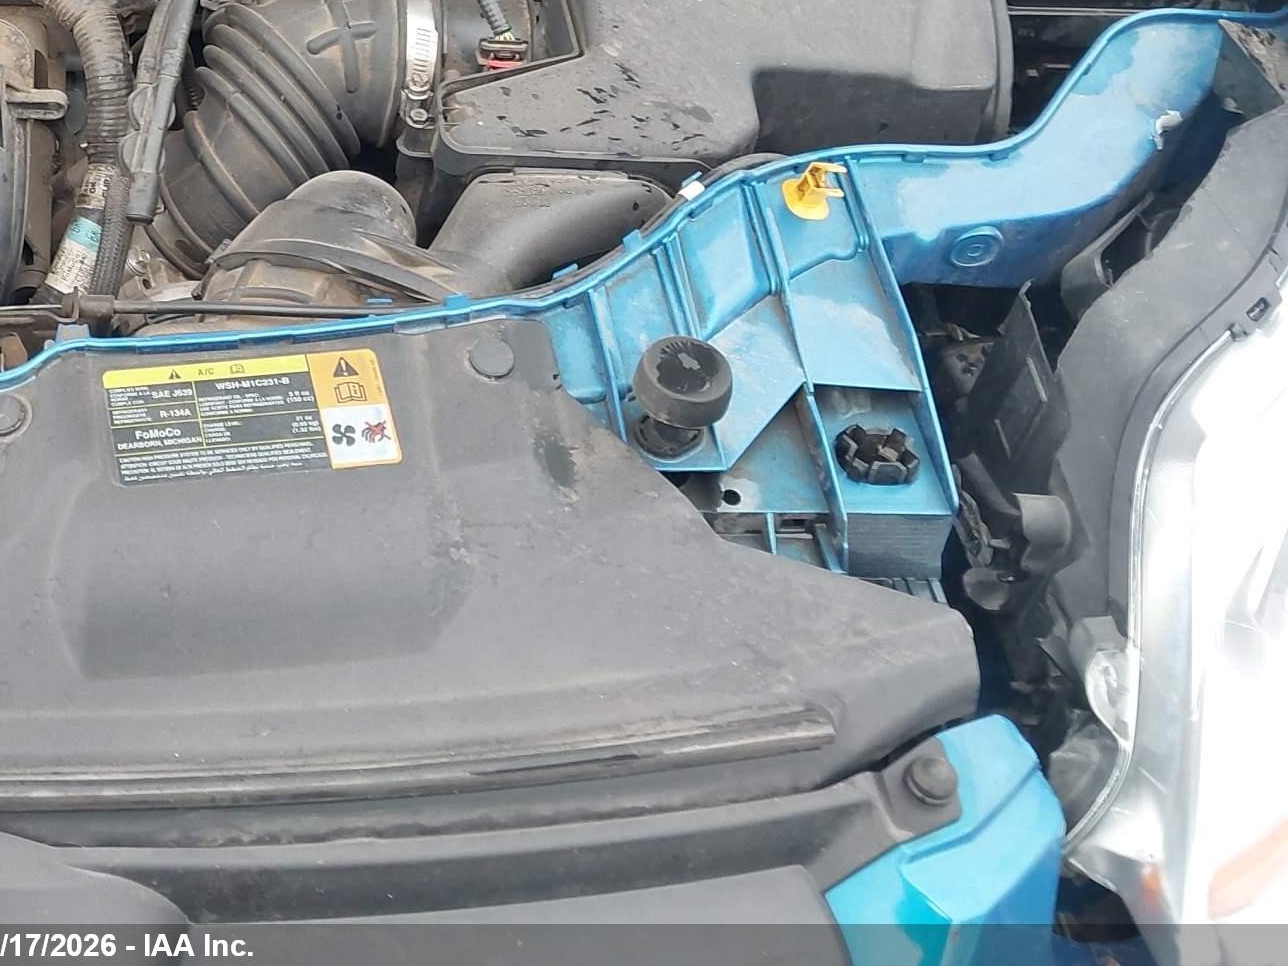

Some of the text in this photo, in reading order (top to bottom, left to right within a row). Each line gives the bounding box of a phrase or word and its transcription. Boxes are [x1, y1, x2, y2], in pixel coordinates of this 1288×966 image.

[197, 367, 215, 376] A/C
[150, 389, 171, 399] SAE
[159, 408, 192, 419] R-134A
[134, 427, 182, 439] FoMoCo
[117, 436, 202, 450] DEARBORN, MICHIGAN
